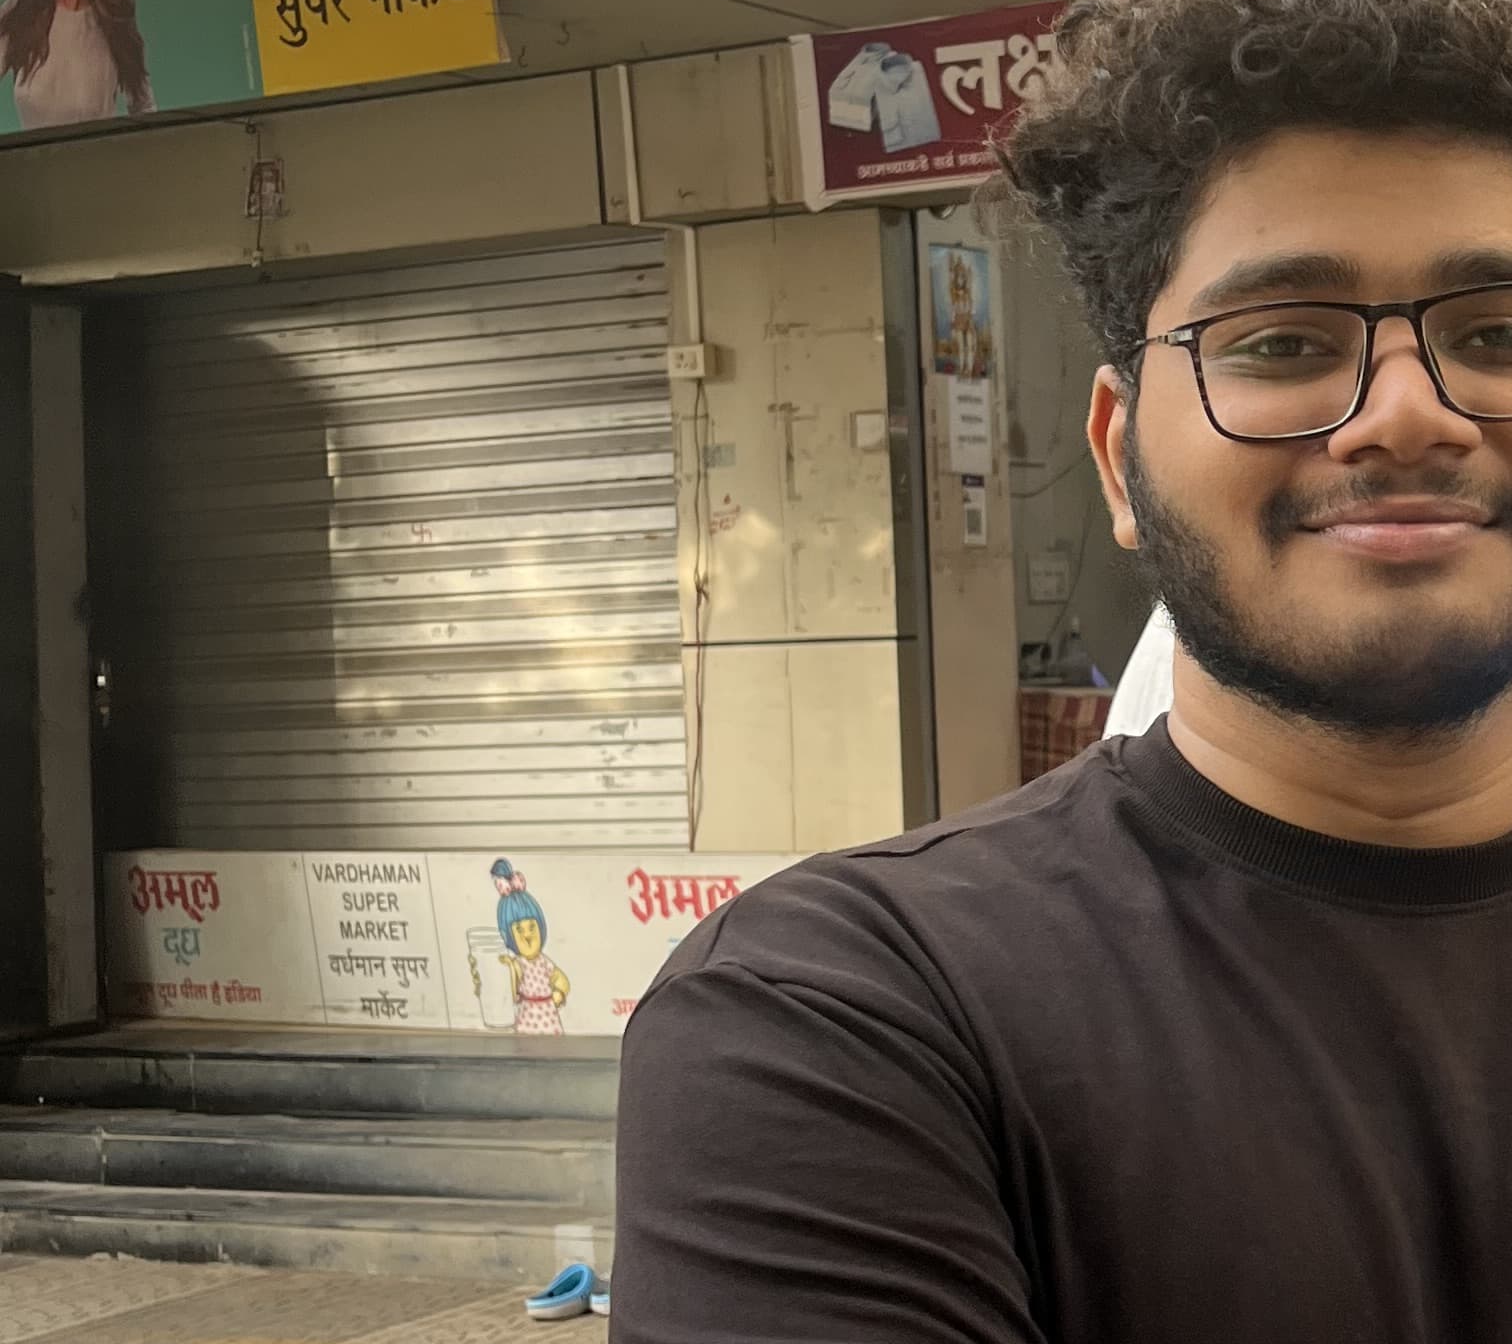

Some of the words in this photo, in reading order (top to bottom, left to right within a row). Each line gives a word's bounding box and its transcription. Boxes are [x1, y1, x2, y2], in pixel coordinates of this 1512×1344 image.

[312, 862, 421, 884] VARDHAMAN
[128, 864, 221, 924] अमूल
[342, 891, 400, 912] SUPER
[339, 920, 409, 941] MARKET
[328, 947, 386, 976] वर्धमान
[390, 956, 429, 988] सुपर
[359, 989, 409, 1019] मार्केट
